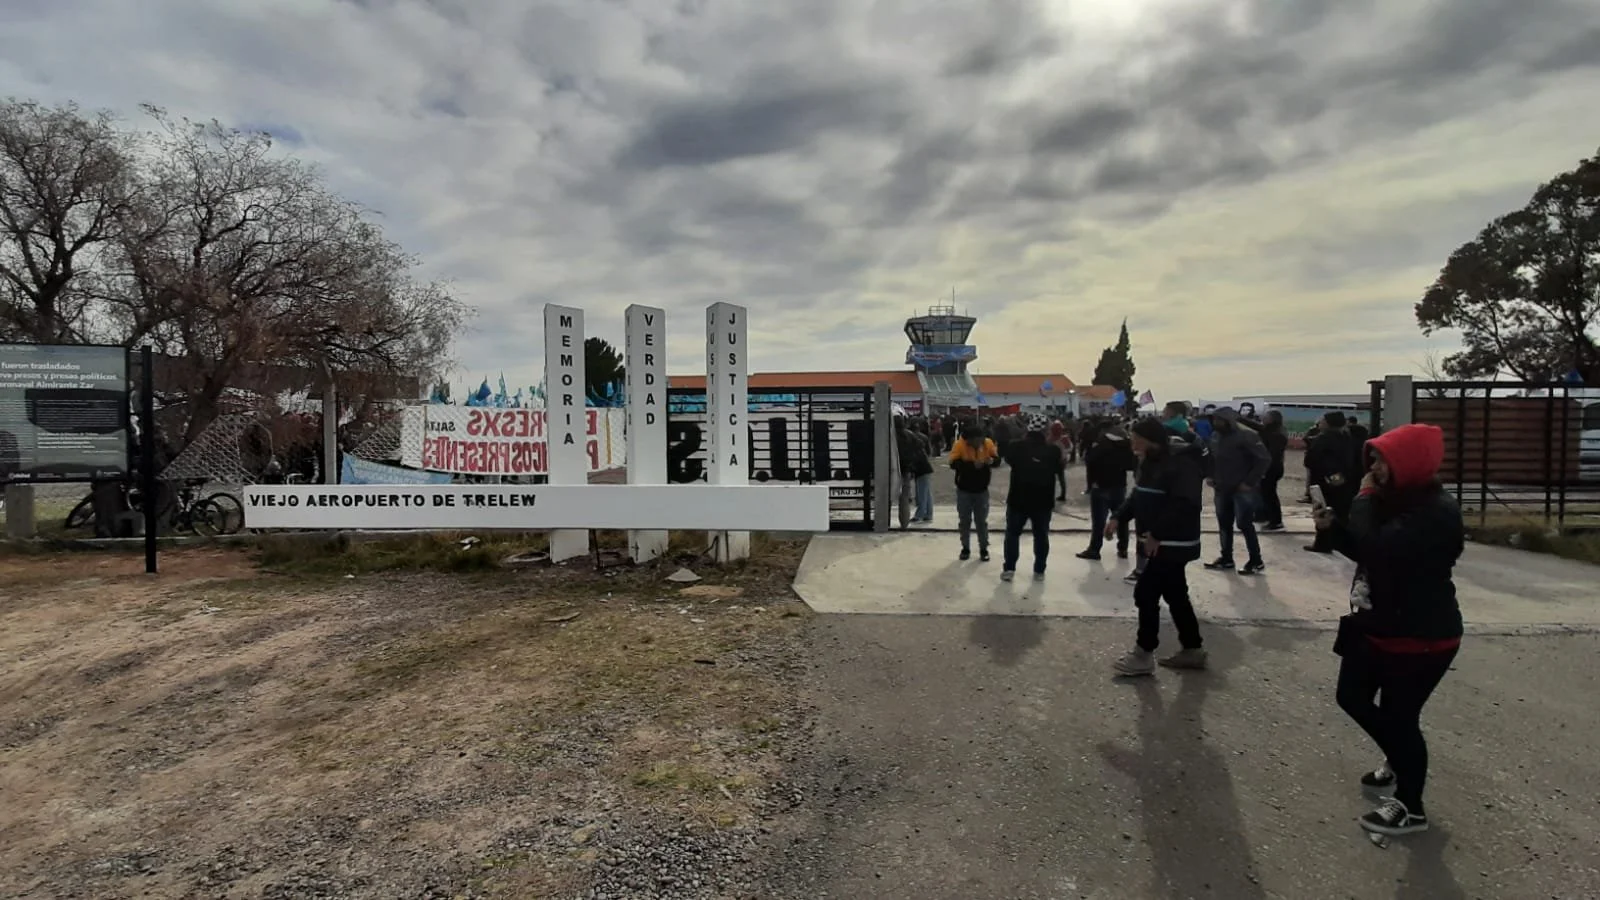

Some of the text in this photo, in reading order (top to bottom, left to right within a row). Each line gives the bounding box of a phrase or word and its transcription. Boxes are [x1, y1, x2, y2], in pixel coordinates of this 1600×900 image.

[30, 362, 80, 370] trasladados
[559, 315, 574, 445] MEMORIA
[644, 313, 656, 426] VERDAD
[728, 312, 739, 467] JUSTICIA
[249, 494, 536, 507] VIEJO AEROPUERTO DE TRELEW
